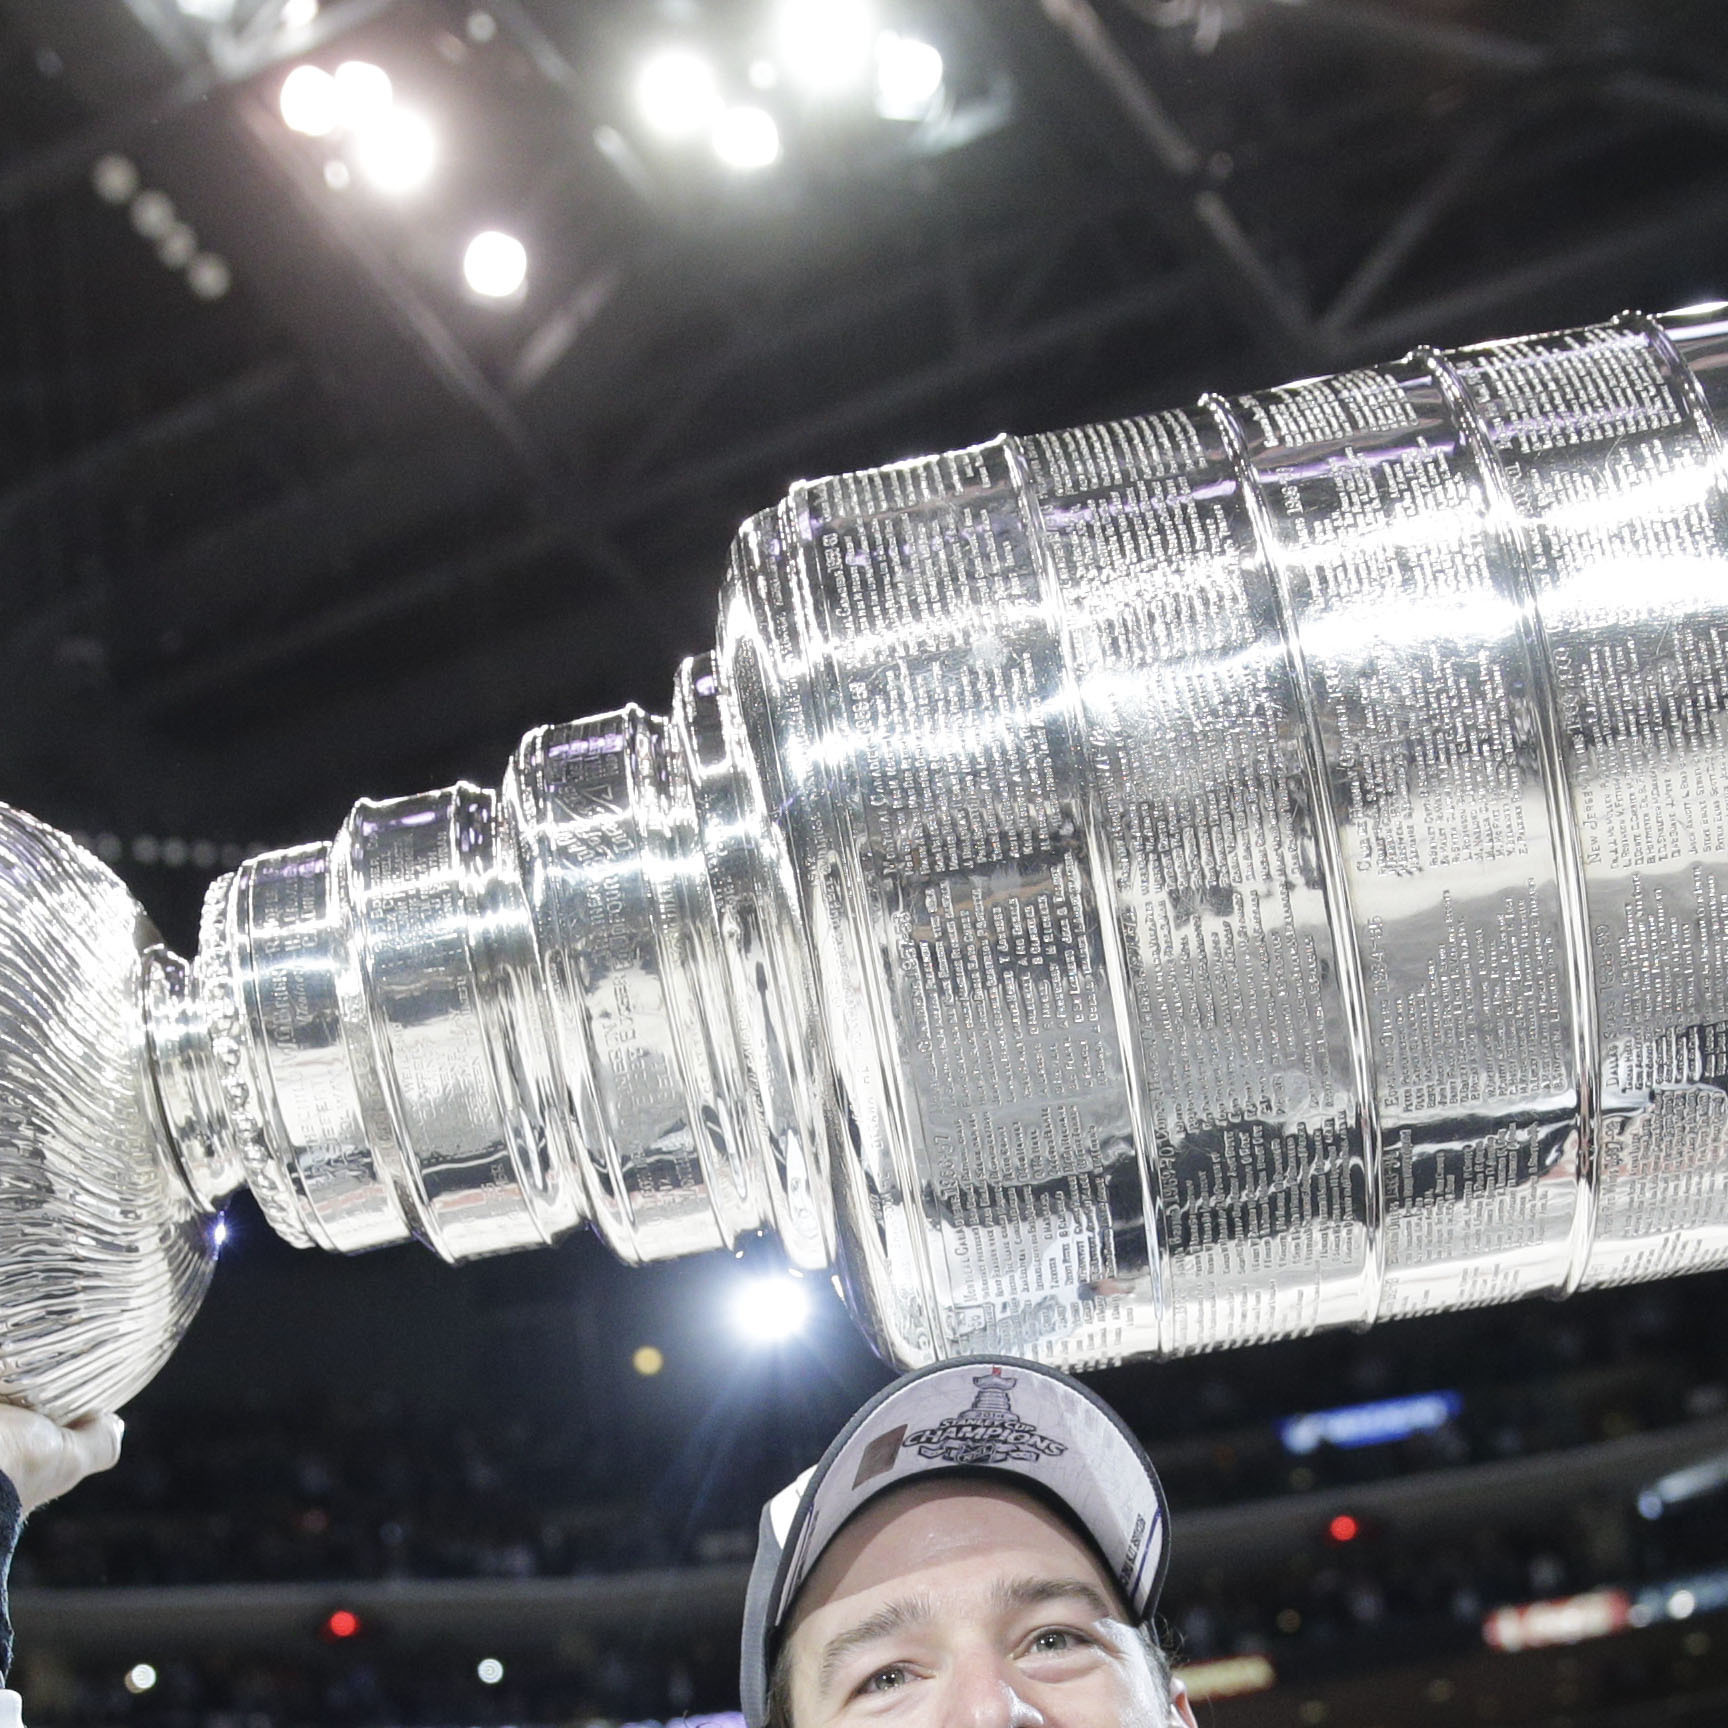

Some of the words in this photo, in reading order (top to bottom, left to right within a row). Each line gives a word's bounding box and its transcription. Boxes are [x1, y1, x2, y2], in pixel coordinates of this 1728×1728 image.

[1586, 834, 1603, 866] NEW
[1604, 1044, 1620, 1088] DALLAS
[903, 1425, 1068, 1457] CHAMPIONS
[940, 1418, 1003, 1429] STANLEY
[1003, 1420, 1036, 1432] CUP
